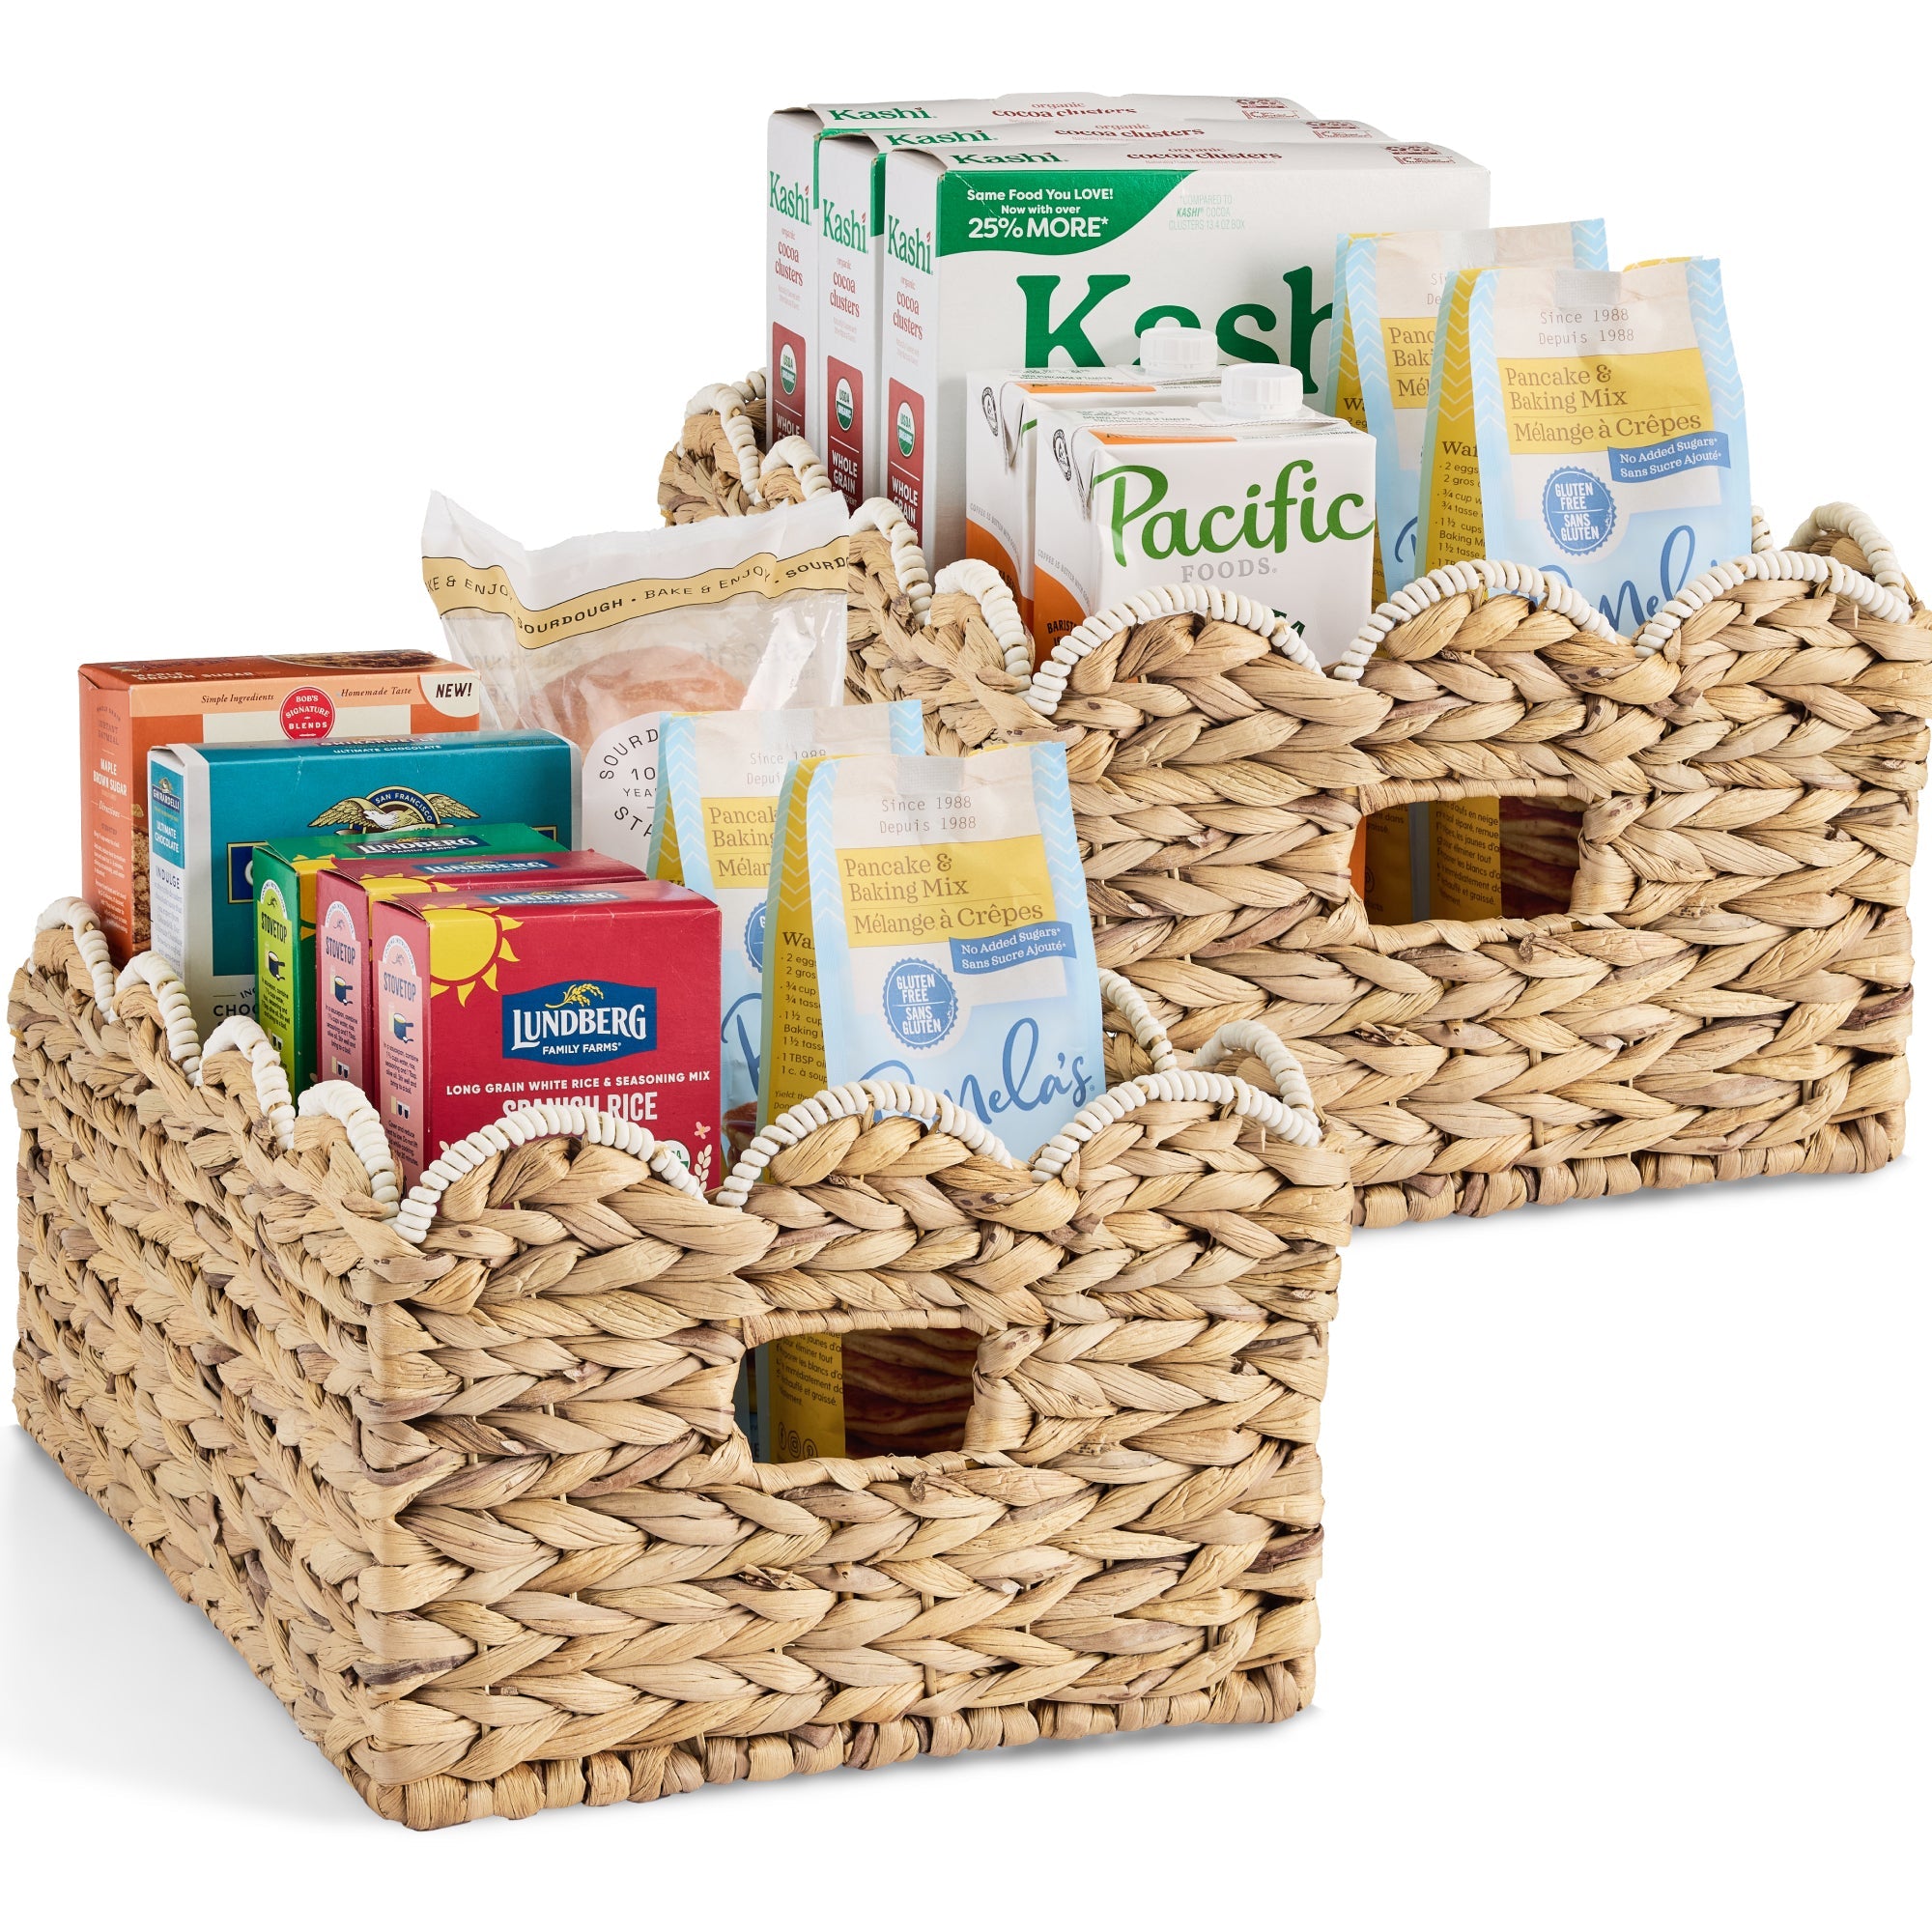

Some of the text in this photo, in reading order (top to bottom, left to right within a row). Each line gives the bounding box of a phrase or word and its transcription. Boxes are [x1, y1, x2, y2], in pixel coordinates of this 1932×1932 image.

[828, 106, 933, 121] Kashi
[992, 107, 1137, 118] cocoa clusters
[886, 129, 993, 146] Kashi
[1055, 128, 1122, 137] cocoa
[1123, 128, 1206, 139] clusters
[949, 152, 1062, 165] Kashi
[1197, 151, 1283, 160] clusters
[770, 171, 810, 226] Kashi
[967, 188, 1114, 201] Same Food You LOVE!
[1001, 204, 1081, 214] Now with over
[823, 198, 867, 254] Kashi
[968, 216, 1024, 239] 25%
[779, 241, 799, 263] cocoa
[888, 214, 932, 274] Kashi
[775, 258, 803, 286] clusters
[833, 271, 856, 294] cocoa
[830, 290, 860, 317] clusters
[896, 291, 920, 315] cocoa
[893, 309, 923, 340] clusters
[1540, 308, 1630, 325] Since 1988
[1539, 329, 1634, 347] Depuis 1988
[1505, 364, 1612, 386] Pancake &
[1510, 388, 1628, 413] Baking Mix
[777, 413, 800, 436] WHOLE
[1514, 413, 1701, 445] Mélange à Crêpes
[1620, 453, 1636, 464] No
[1638, 444, 1675, 464] Added
[832, 449, 858, 478] WHOLE
[1620, 467, 1648, 479] Sans
[1649, 458, 1682, 475] Sucre
[834, 469, 856, 495] GRAIN
[892, 475, 918, 506] WHOLE
[1453, 477, 1475, 487] gros
[1554, 483, 1594, 497] GLUTEN
[1455, 492, 1472, 503] cup
[1560, 497, 1587, 511] FREE
[1094, 460, 1376, 567] Pacific
[1455, 505, 1478, 518] tasse
[1564, 513, 1591, 527] SANS
[1439, 530, 1472, 546] Baking
[1461, 523, 1482, 535] cups
[1560, 526, 1600, 542] GLUTEN
[1457, 547, 1480, 559] tasse
[785, 556, 847, 579] SOURD
[446, 576, 512, 600] & ENJO
[645, 566, 770, 600] BAKE & ENJOY
[201, 693, 274, 704] Simple Ingredients
[296, 695, 319, 703] BOB'S
[341, 688, 387, 697] Homemade
[436, 683, 472, 698] NEW!
[285, 705, 329, 719] SIGNATURE
[289, 722, 327, 730] BLENDS
[599, 728, 659, 780] SOURD
[750, 753, 783, 765] Since
[100, 758, 117, 776] MAPLE
[110, 779, 127, 796] SUGAR
[747, 773, 782, 786] Depui
[376, 792, 432, 821] SAN FRANCISCO
[881, 796, 973, 812] Since 1988
[709, 807, 778, 826] Pancak
[880, 816, 977, 835] Depuis 1988
[156, 820, 177, 838] ULTIMATE
[155, 832, 179, 853] CHOCOLATE
[357, 836, 479, 855] LUNDBERG
[424, 860, 549, 873] LUNDBERG
[844, 853, 952, 877] Pancake &
[156, 866, 180, 889] INDULGE
[484, 891, 618, 904] LUNDBERG
[849, 877, 970, 903] Baking Mix
[261, 911, 288, 944] STOVETOP
[854, 903, 1043, 936] Mélange à Crêpes
[326, 936, 356, 966] STOVETOP
[961, 944, 979, 955] No
[980, 936, 1017, 953] Added
[961, 958, 990, 970] Sans
[992, 949, 1024, 966] Sucre
[794, 969, 816, 980] gros
[896, 974, 936, 990] GLUTEN
[384, 971, 416, 1004] STOVETOP
[799, 984, 816, 996] cup
[902, 988, 929, 1003] FREE
[905, 1007, 933, 1020] SANS
[511, 1004, 647, 1051] LUNDBERG
[784, 1024, 818, 1038] Baking
[902, 1019, 942, 1036] GLUTEN
[542, 1043, 581, 1055] FAMILY
[789, 1054, 813, 1065] TBSP
[446, 1070, 710, 1095] LONG GRAIN WHITE RICE & SEASONING MIX
[609, 1092, 658, 1122] RICE
